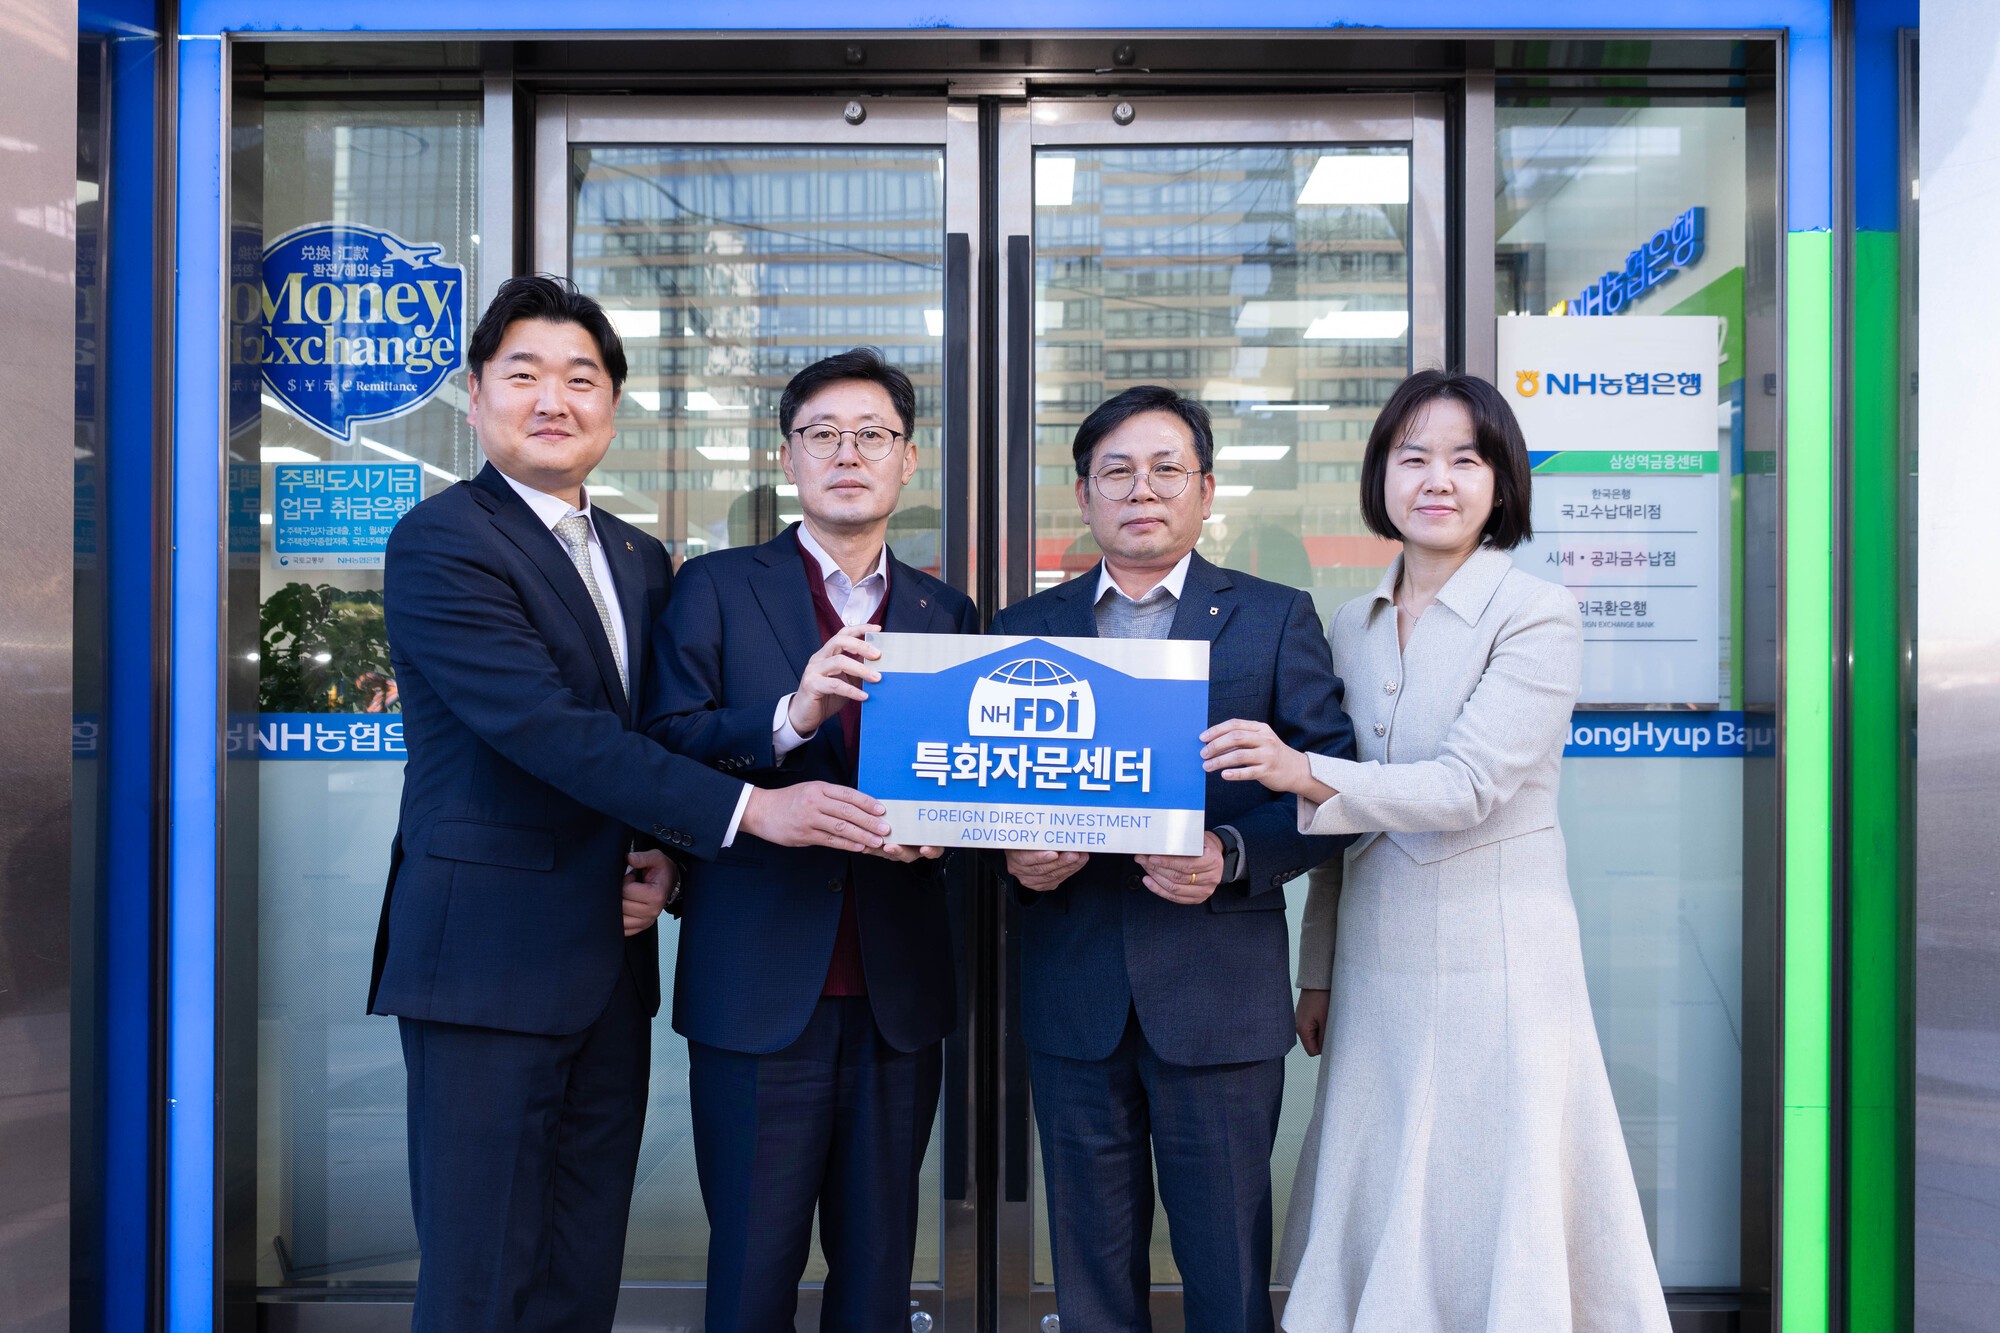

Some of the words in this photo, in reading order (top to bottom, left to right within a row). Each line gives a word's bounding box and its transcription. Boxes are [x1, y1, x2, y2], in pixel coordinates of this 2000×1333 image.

[313, 263, 394, 278] 환전/해외송금
[262, 272, 457, 338] Money
[356, 379, 418, 392] Remittance
[1546, 372, 1702, 396] NH농협은행
[1609, 454, 1703, 470] 삼성역금융센터
[279, 468, 417, 493] 주택도시기금
[1591, 488, 1631, 500] 한국은행
[280, 496, 324, 521] 업무
[330, 496, 415, 521] 취급은행
[1561, 503, 1662, 520] 국고수납대리점
[1546, 551, 1575, 567] 시세
[1590, 551, 1676, 567] 공과금수납점
[1598, 621, 1635, 629] EXCHANGE
[1636, 621, 1655, 629] BANK
[981, 705, 1010, 724] NH
[911, 741, 1151, 793] 특화자문센터
[917, 808, 986, 824] FOREIGN
[989, 810, 1045, 826] DIRECT
[1050, 812, 1152, 829] INVESTMENT
[961, 828, 1041, 844] ADVISORY
[1044, 830, 1107, 846] CENTER
